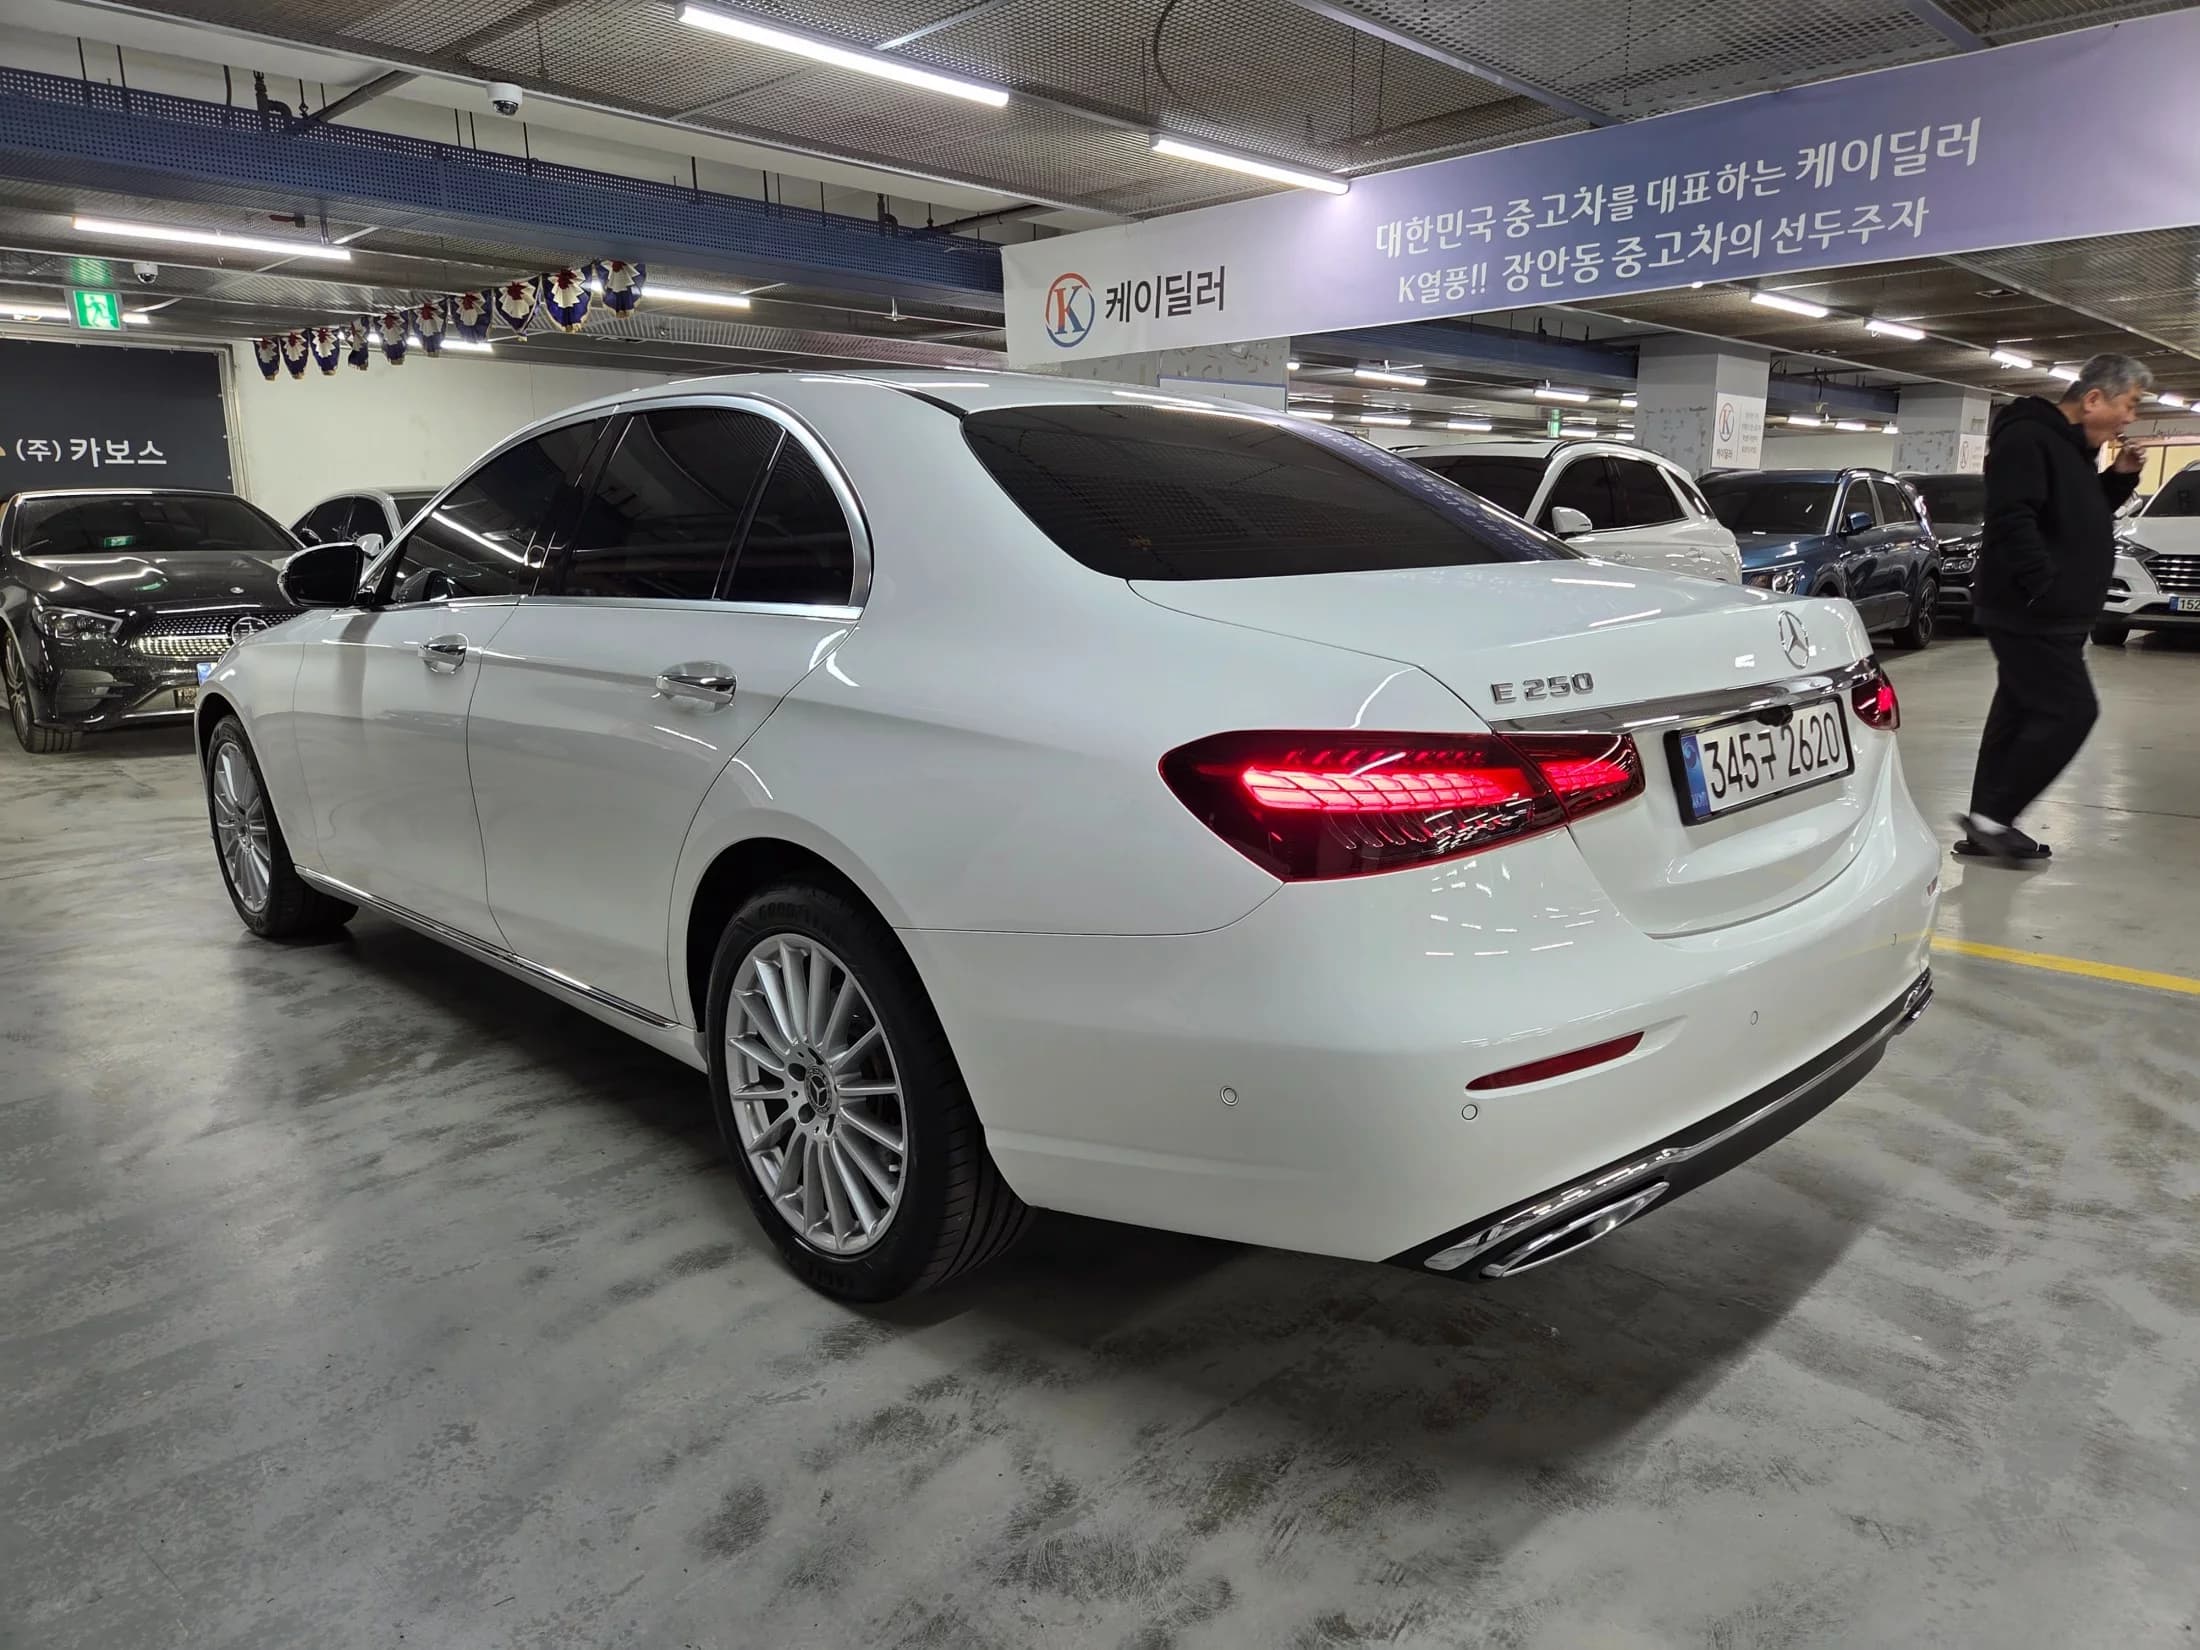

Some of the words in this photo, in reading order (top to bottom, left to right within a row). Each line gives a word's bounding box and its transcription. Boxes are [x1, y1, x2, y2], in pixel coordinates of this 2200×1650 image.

[1376, 205, 1496, 258] 대한민국
[1503, 184, 1638, 238] 중고차를
[1647, 170, 1711, 214] 대표
[1716, 159, 1786, 201] 하는
[1795, 117, 1981, 188] 케이딜러
[1398, 262, 1487, 304] K열풍!!
[1502, 243, 1604, 292] 장안동
[1611, 219, 1763, 278] 중고차의
[1770, 197, 1929, 254] 선두주자
[1105, 265, 1226, 323] 케이딜러
[16, 438, 61, 462] (주)
[69, 437, 167, 467] 카보스
[1491, 683, 1517, 705] E
[1523, 672, 1594, 702] 250
[1780, 712, 1840, 777] 2620
